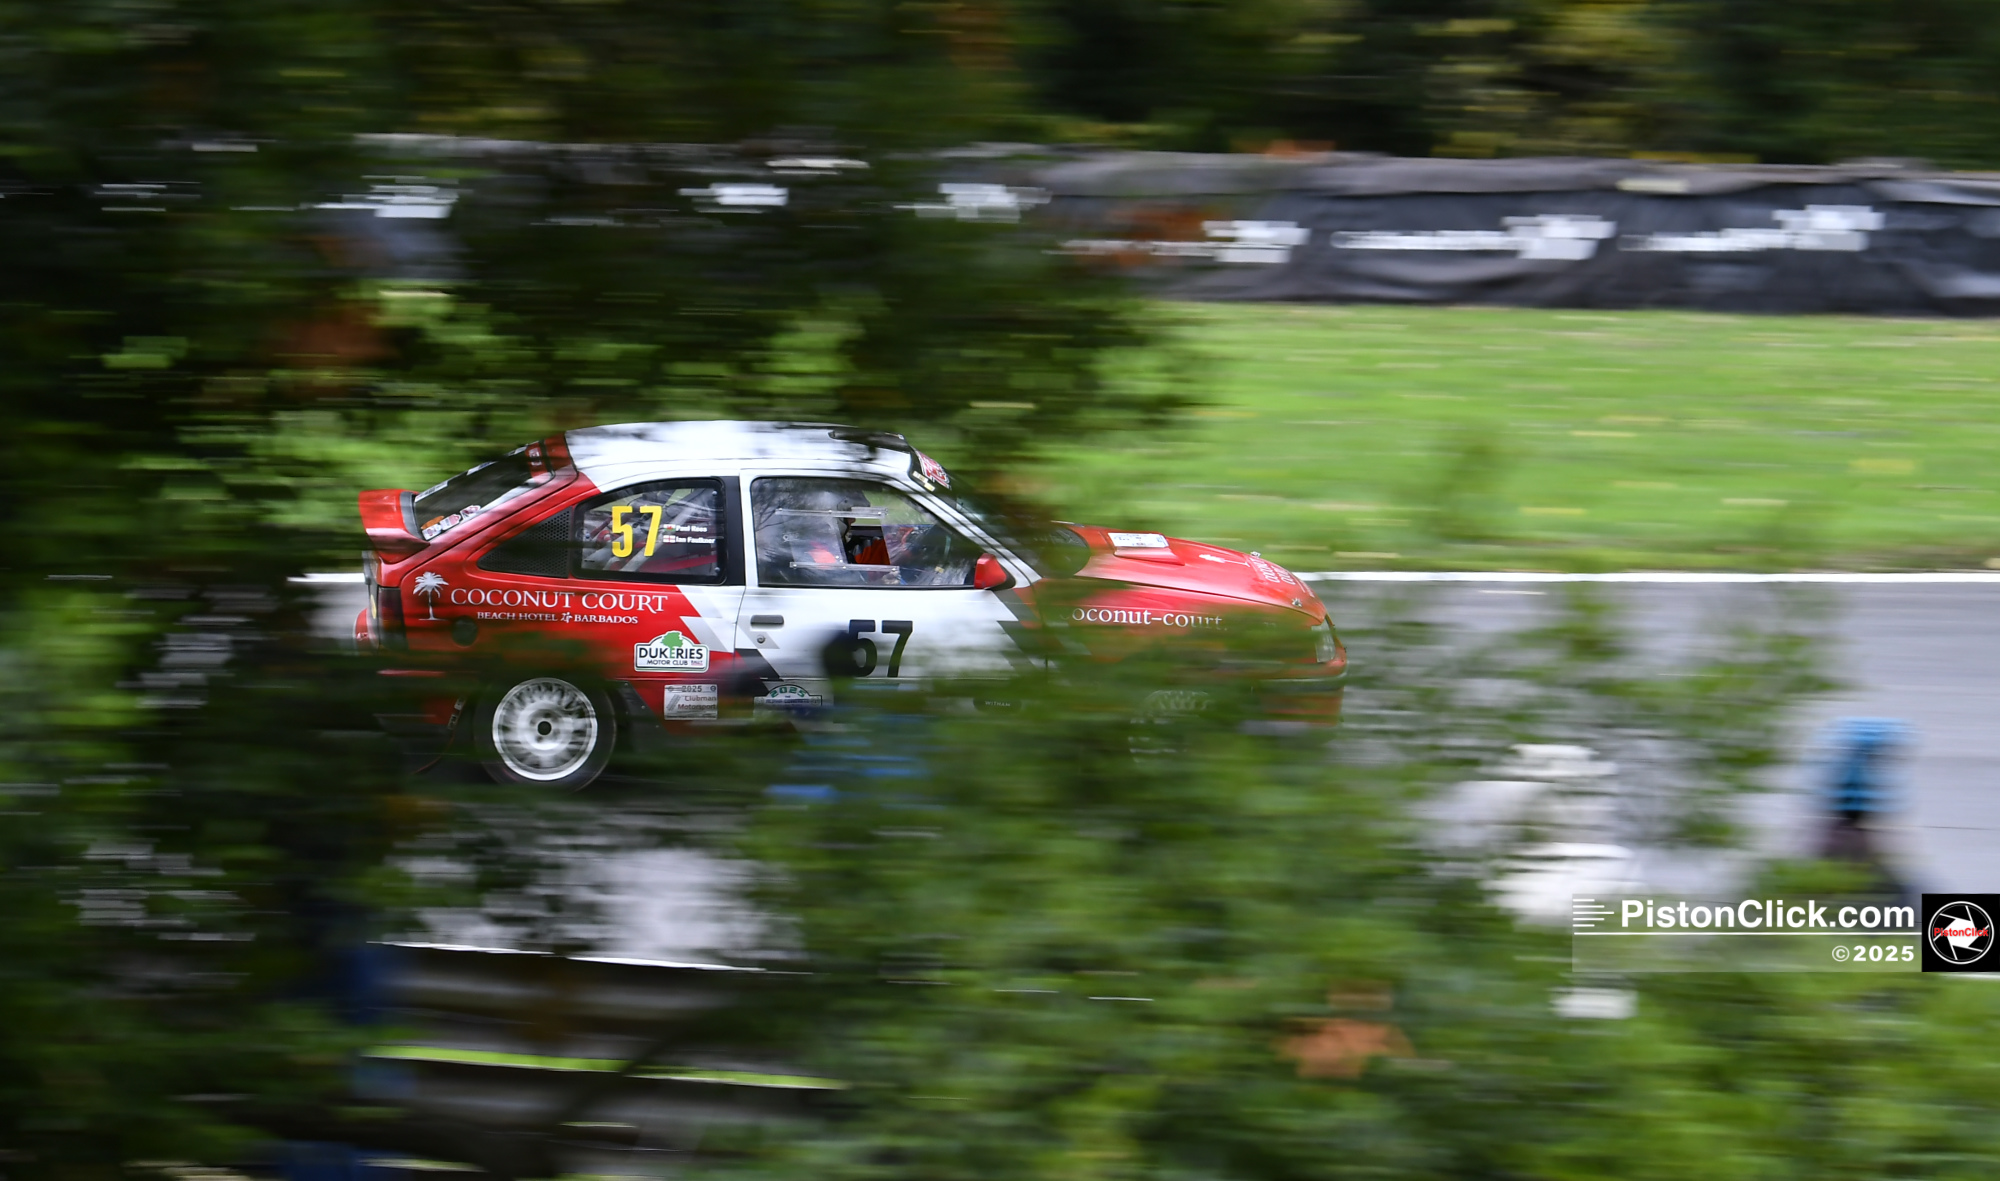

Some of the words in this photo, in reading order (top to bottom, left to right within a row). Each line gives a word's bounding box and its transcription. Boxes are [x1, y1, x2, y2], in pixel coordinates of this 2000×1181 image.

[611, 505, 662, 558] 57
[450, 588, 576, 610] COCONUT
[582, 593, 669, 614] COURT
[477, 611, 517, 620] BEACH
[519, 612, 559, 622] HOTEL
[574, 614, 639, 624] BARBADOS
[638, 647, 704, 660] DUKERIES
[847, 619, 913, 678] 57
[681, 685, 702, 693] 2025
[769, 686, 807, 698] 2025
[677, 703, 717, 711] Motorsport
